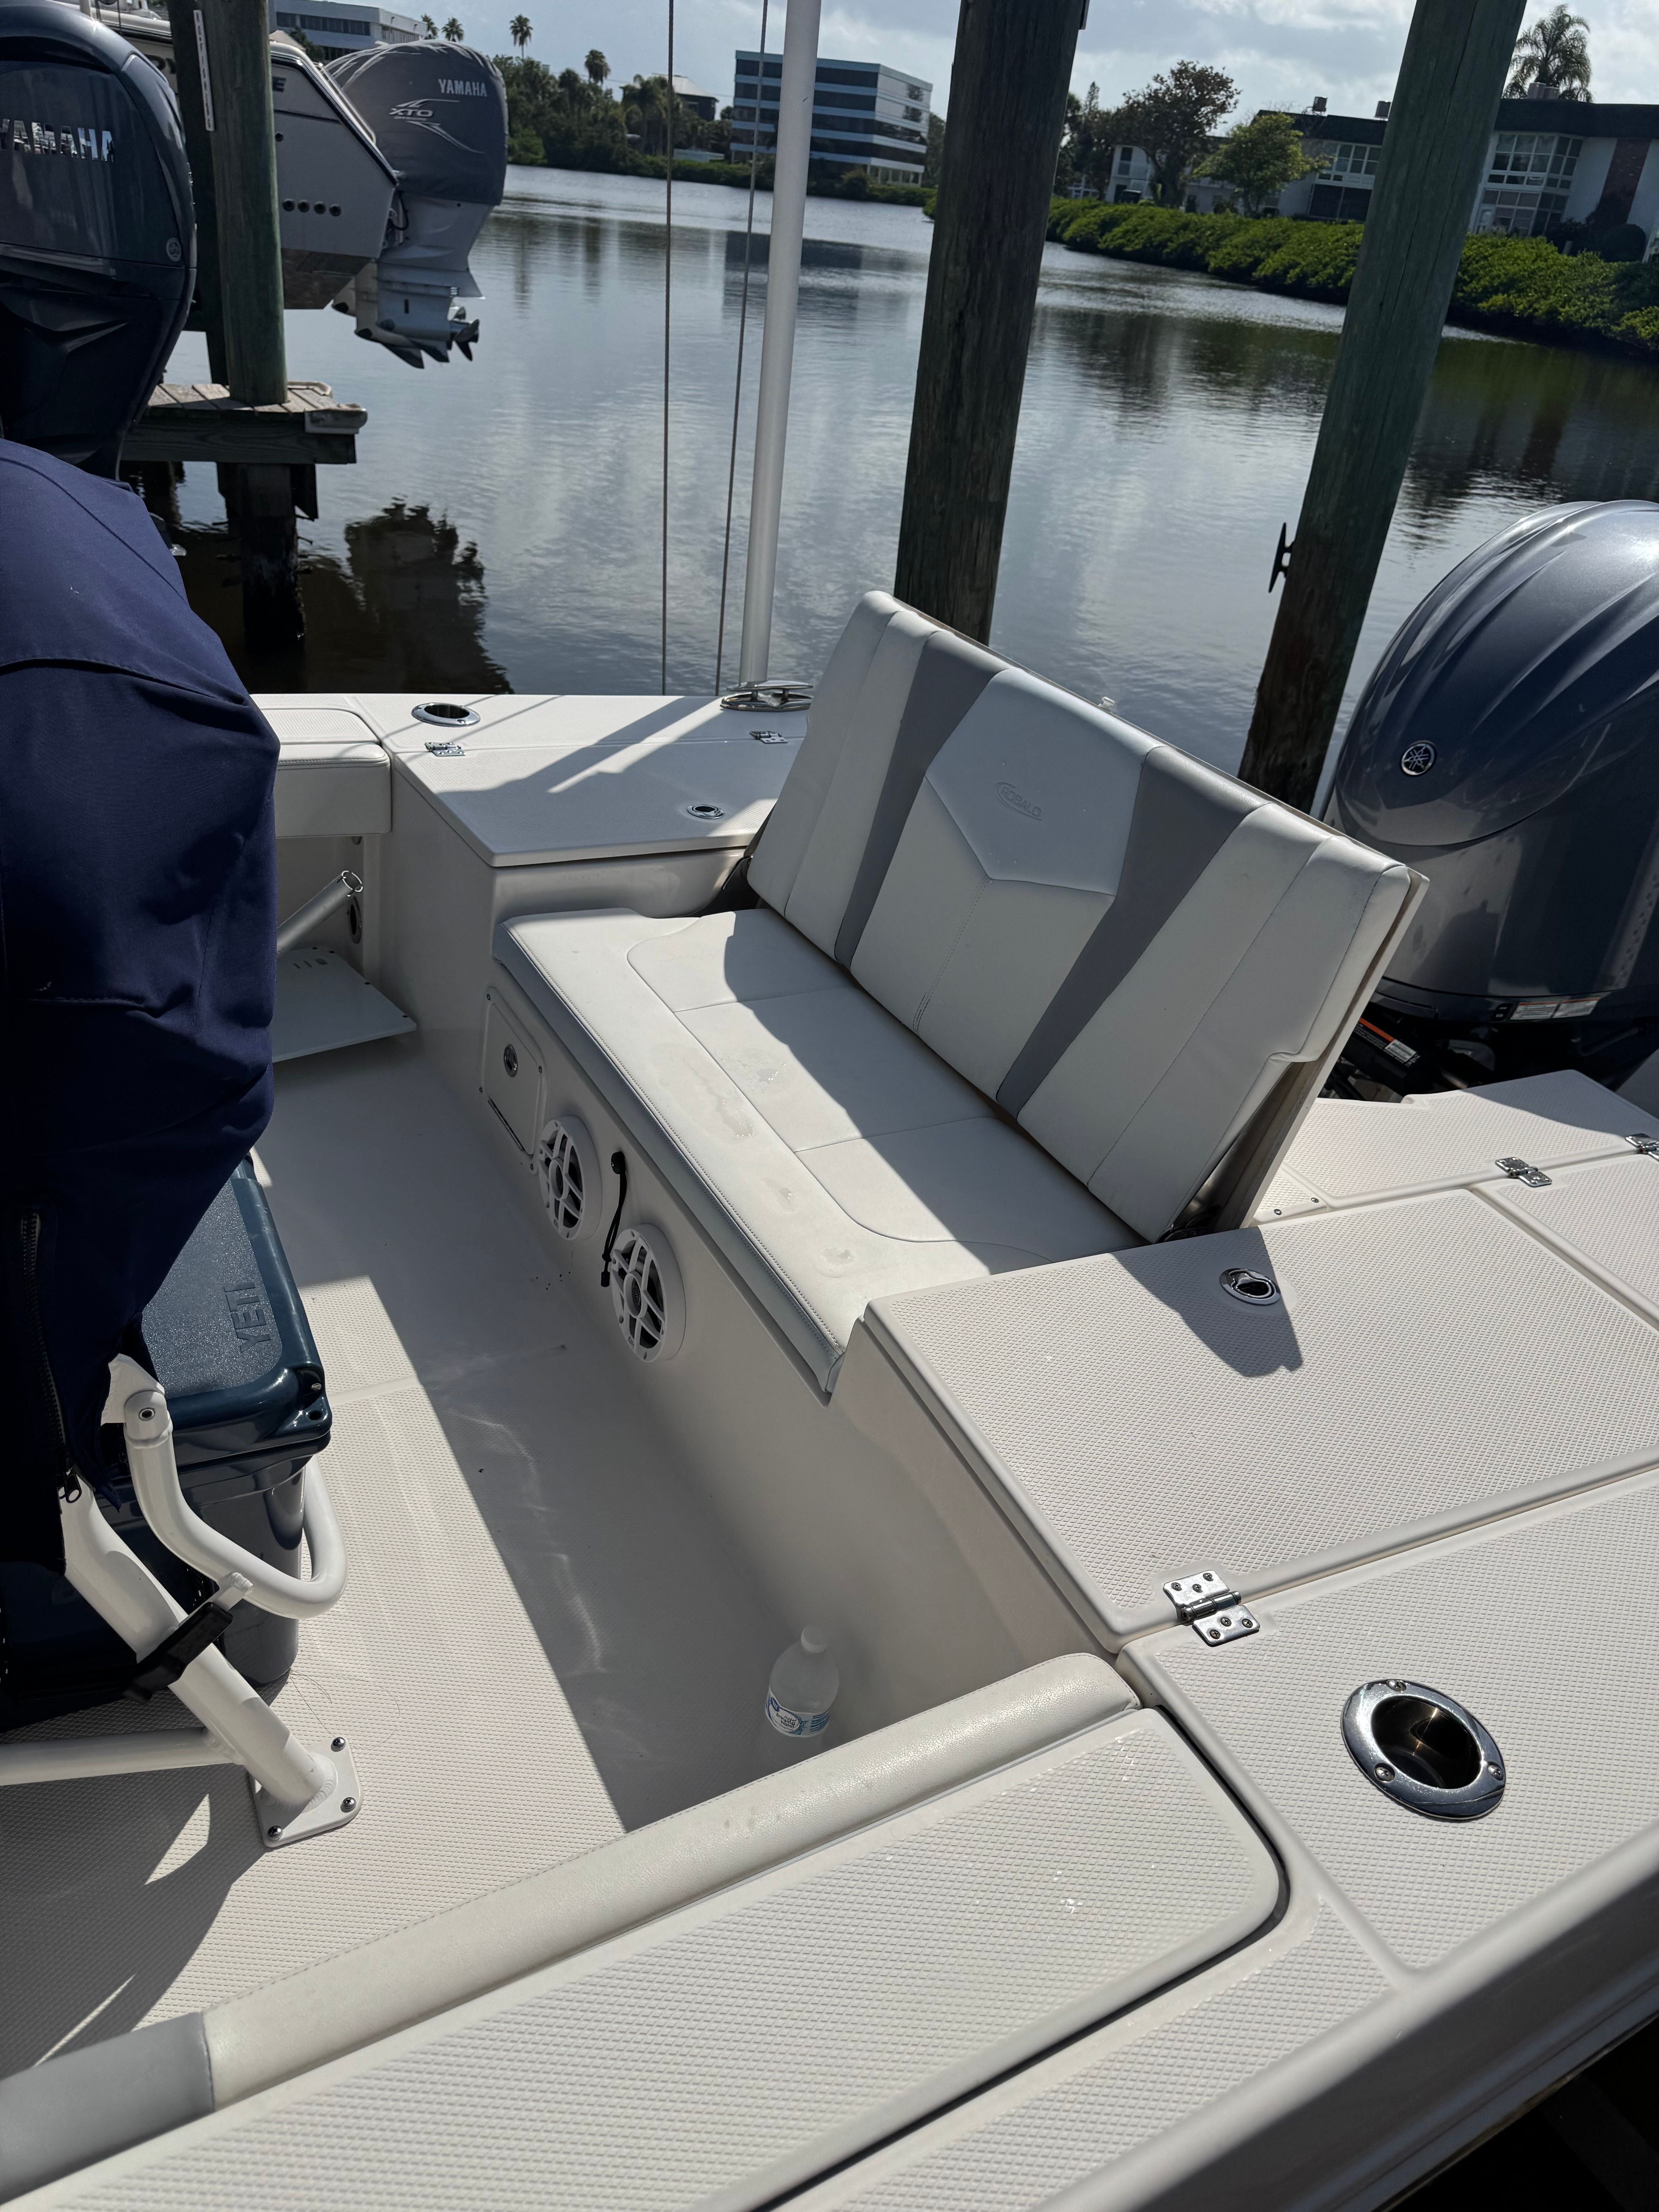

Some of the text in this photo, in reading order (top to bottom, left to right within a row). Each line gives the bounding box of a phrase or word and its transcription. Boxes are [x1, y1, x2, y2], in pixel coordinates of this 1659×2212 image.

[438, 79, 487, 96] YAMAHA
[388, 108, 434, 117] XTO
[0, 118, 114, 162] YAMAHA
[1000, 786, 1042, 817] ROBALO
[223, 1282, 272, 1353] YETI
